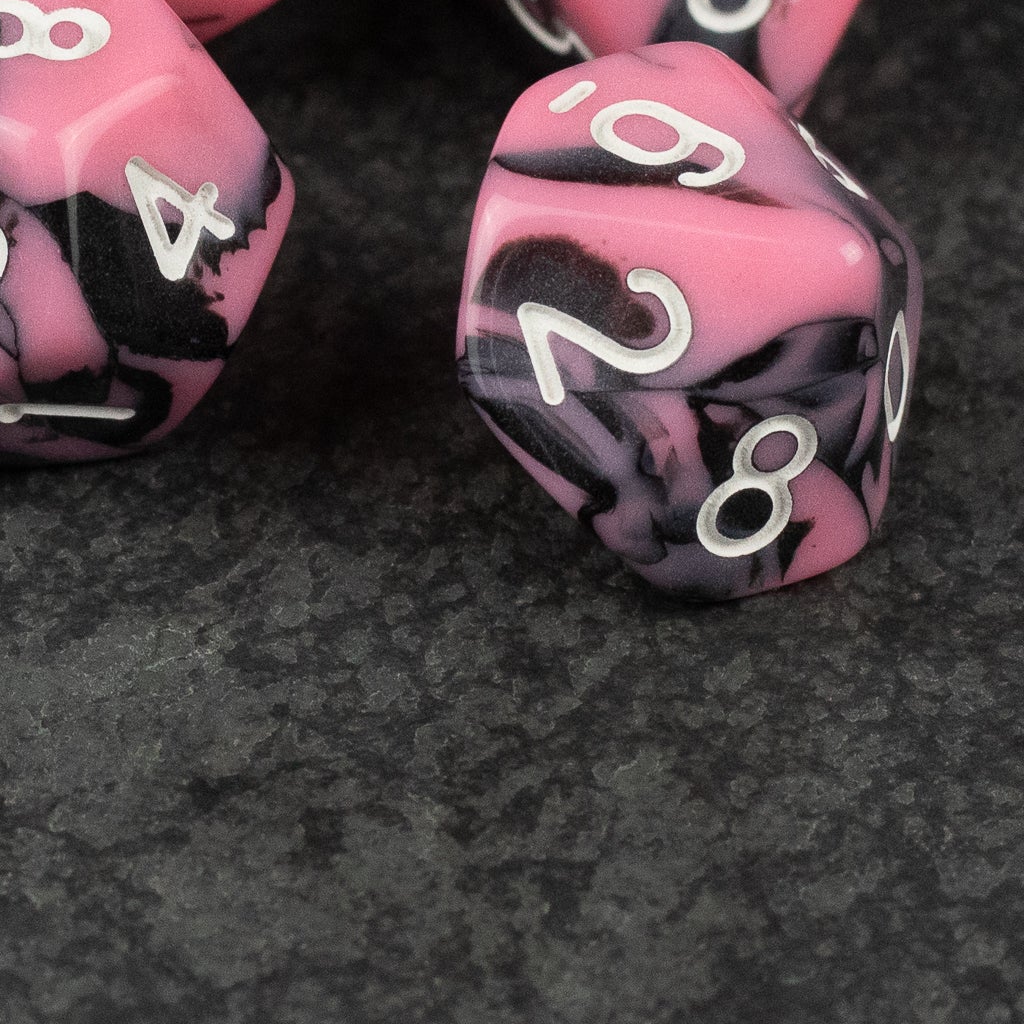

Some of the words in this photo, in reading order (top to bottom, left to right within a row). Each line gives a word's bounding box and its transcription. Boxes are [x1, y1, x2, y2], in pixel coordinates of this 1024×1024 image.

[124, 155, 237, 282] 4
[516, 267, 693, 407] 2
[695, 413, 820, 559] 8
